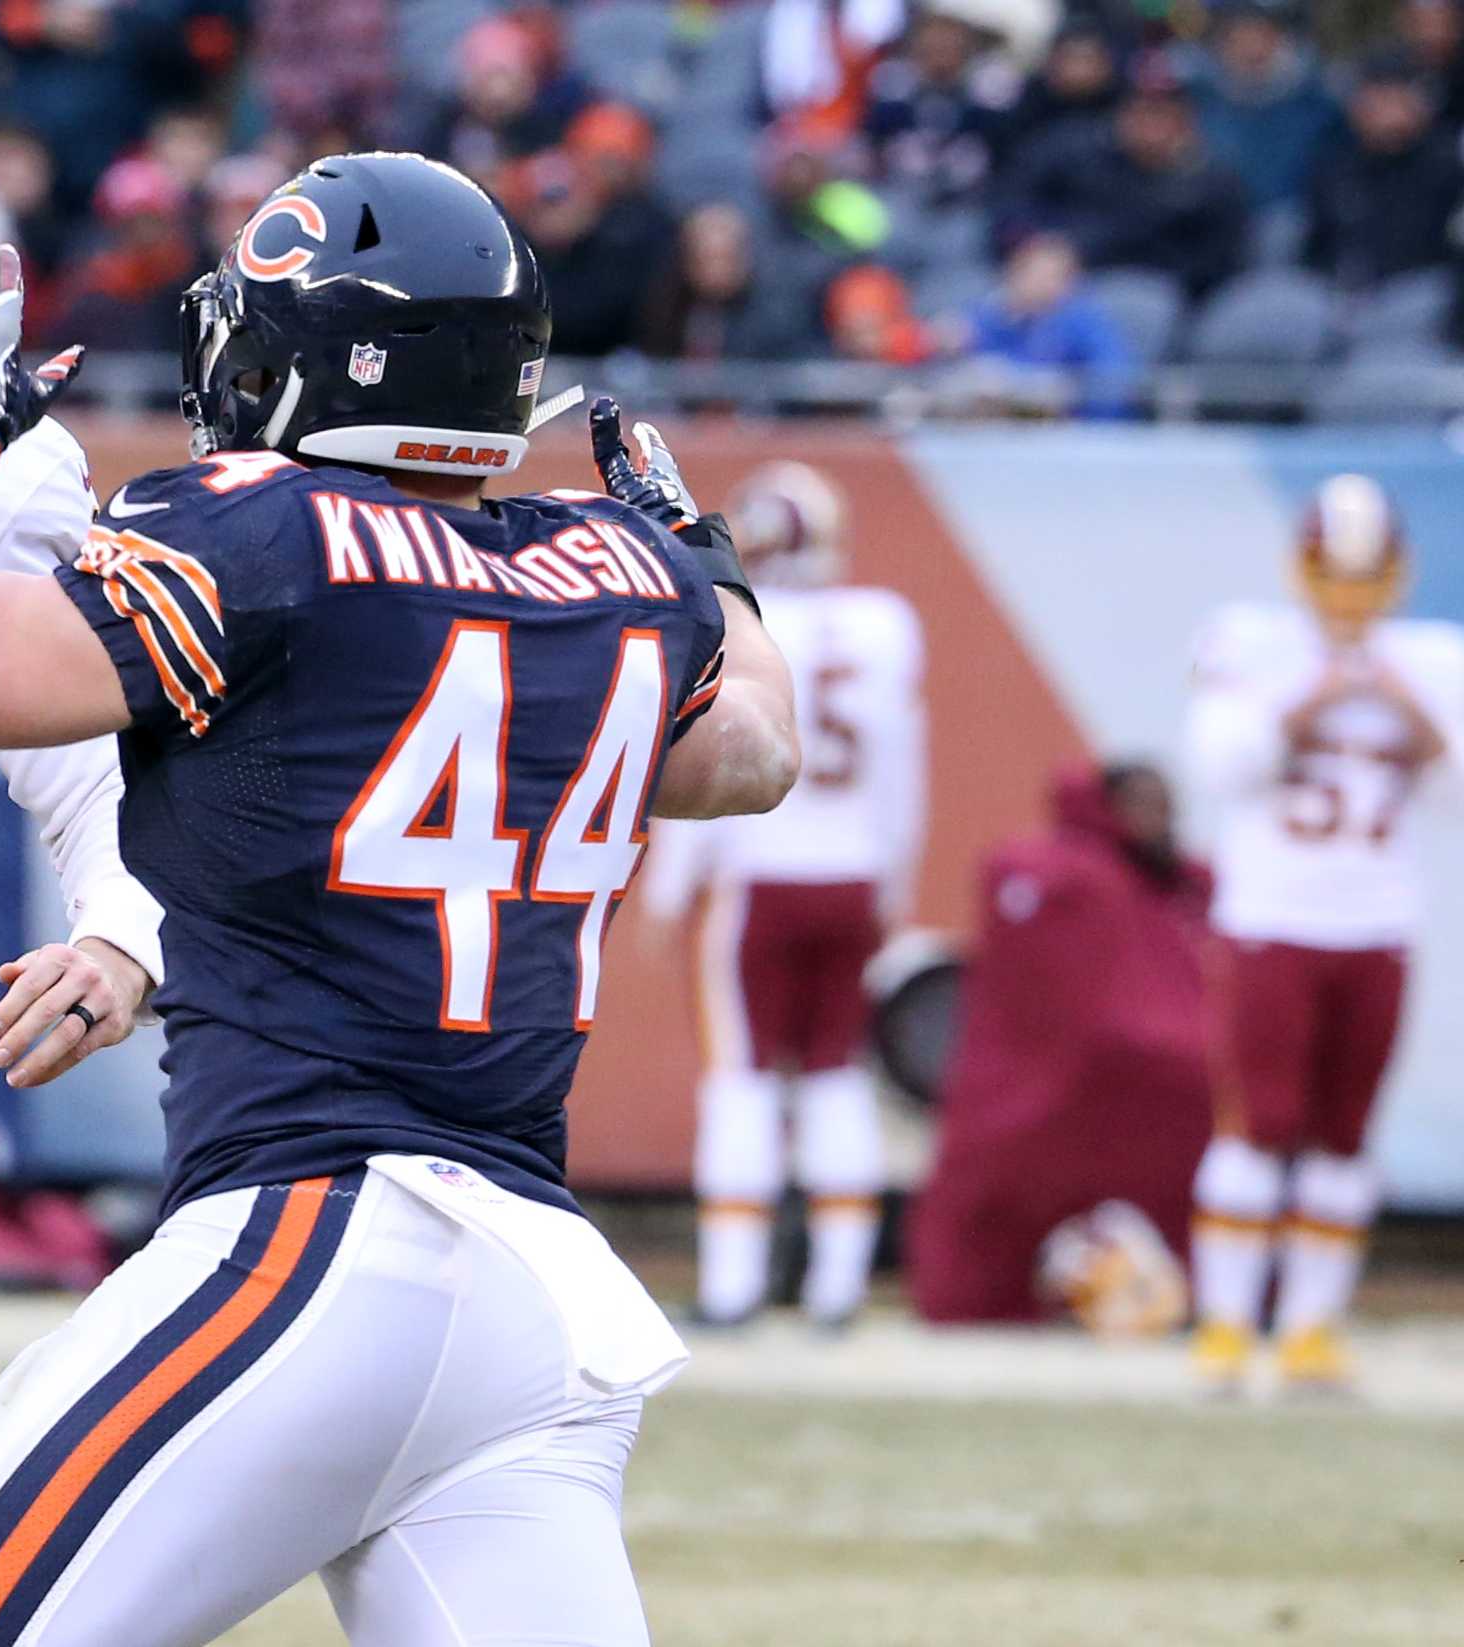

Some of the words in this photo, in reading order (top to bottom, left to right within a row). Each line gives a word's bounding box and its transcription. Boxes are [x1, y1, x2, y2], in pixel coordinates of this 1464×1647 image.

[237, 194, 327, 283] C
[354, 360, 380, 379] NFL
[394, 441, 509, 467] BEARS
[326, 619, 669, 1032] 44
